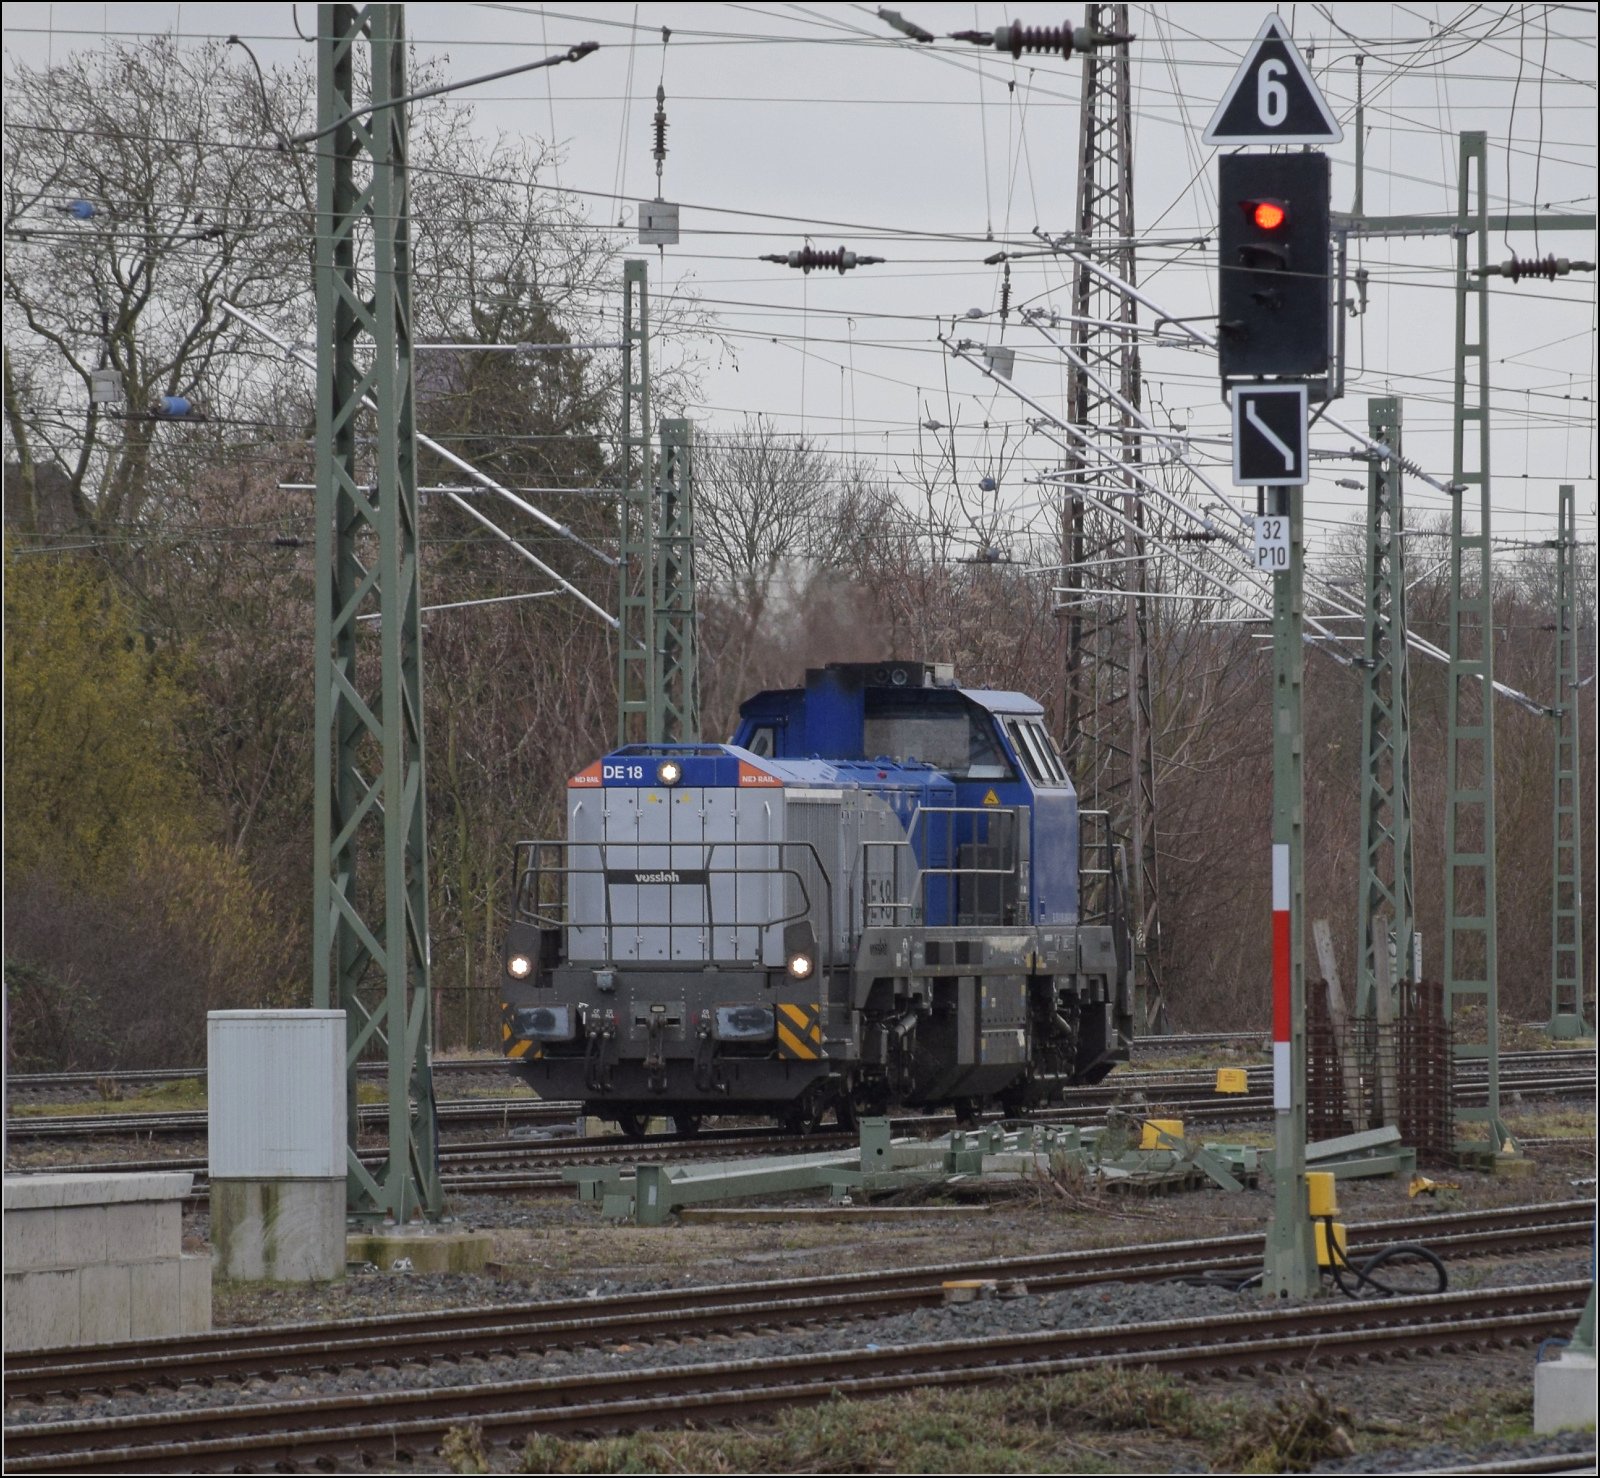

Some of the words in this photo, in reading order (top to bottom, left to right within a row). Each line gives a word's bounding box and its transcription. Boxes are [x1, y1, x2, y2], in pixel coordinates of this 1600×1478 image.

[1257, 58, 1288, 127] 6
[1262, 520, 1281, 540] 32
[1258, 546, 1286, 566] P10
[603, 765, 625, 779] DE
[626, 765, 643, 780] 18
[757, 775, 775, 783] RAIL
[634, 871, 680, 883] vossloh
